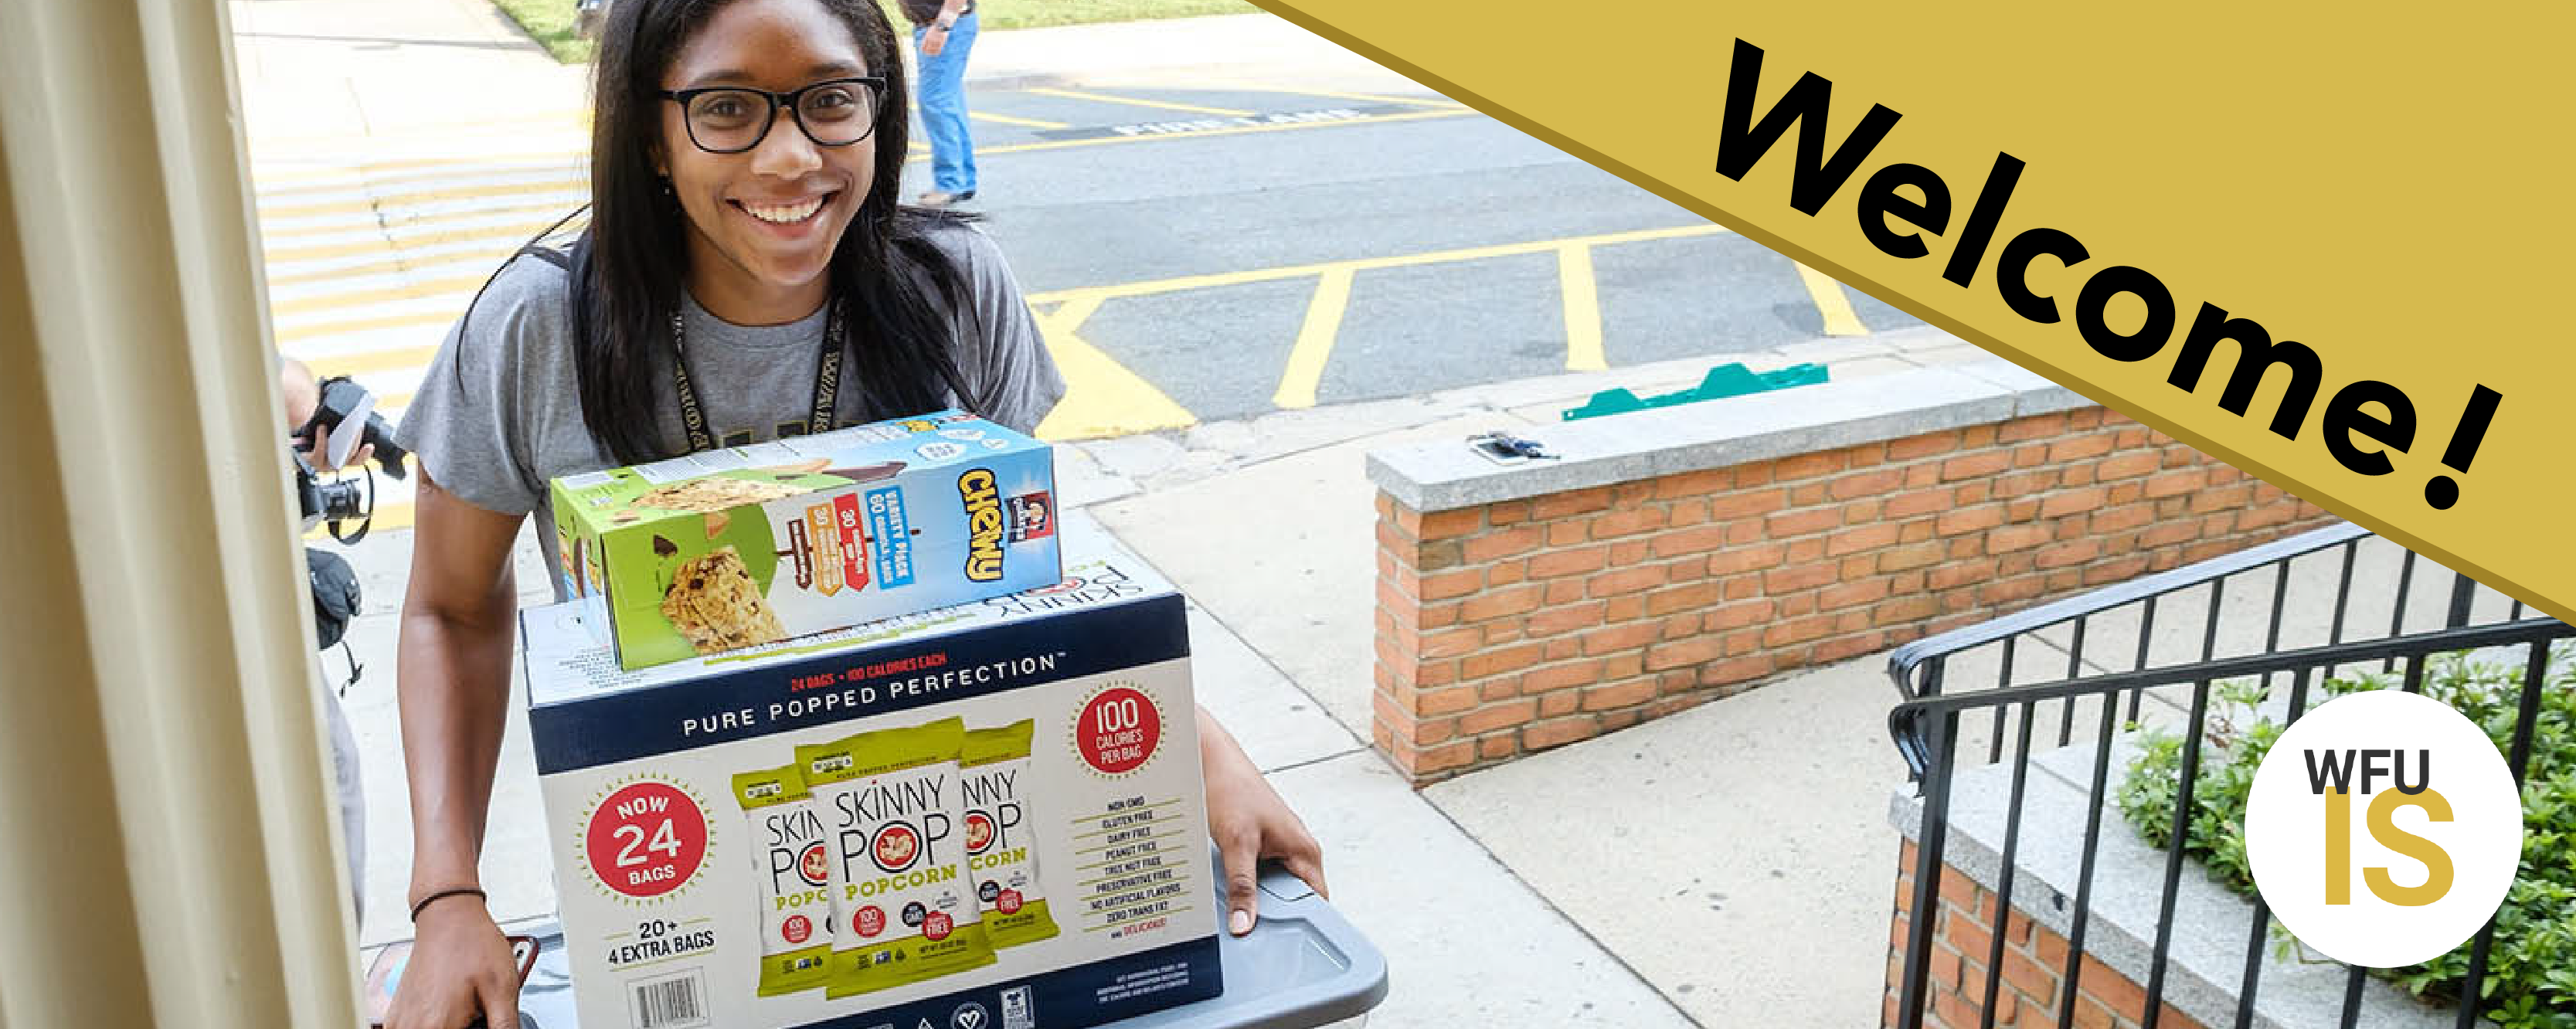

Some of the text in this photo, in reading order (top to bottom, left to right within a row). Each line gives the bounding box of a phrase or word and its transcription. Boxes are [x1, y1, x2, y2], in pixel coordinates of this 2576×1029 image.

[870, 494, 885, 513] 60
[841, 509, 856, 527] 30
[885, 492, 911, 577] VARIETY PACK
[866, 657, 917, 679] CALORIES
[683, 708, 756, 736] PURE
[770, 688, 876, 720] POPPED
[1096, 698, 1139, 735] 100
[1096, 728, 1144, 750] CALORIES
[1101, 743, 1144, 764] PER BAG
[617, 796, 670, 820] NOW
[835, 773, 944, 828] SKINNY
[1102, 810, 1154, 829] GLUTEN FREE
[613, 818, 682, 868] 24
[1106, 826, 1150, 844] DAIRY FREE
[839, 813, 951, 883] POP
[970, 846, 1027, 871] CORN
[1105, 841, 1157, 860] PEANUT FREE
[628, 864, 676, 885] BAGS
[1105, 864, 1123, 875] TREE
[1142, 855, 1161, 867] FREE
[844, 863, 957, 900] POPCORN
[1096, 868, 1172, 892] PRESERVATIVE FREE
[1090, 882, 1181, 910] NO ARTIFICIAL FLAVORS
[1106, 908, 1127, 924] ZERO
[1128, 903, 1154, 918] TRANS
[639, 919, 678, 939] 20+
[607, 930, 715, 965] 4 EXTRA BAGS
